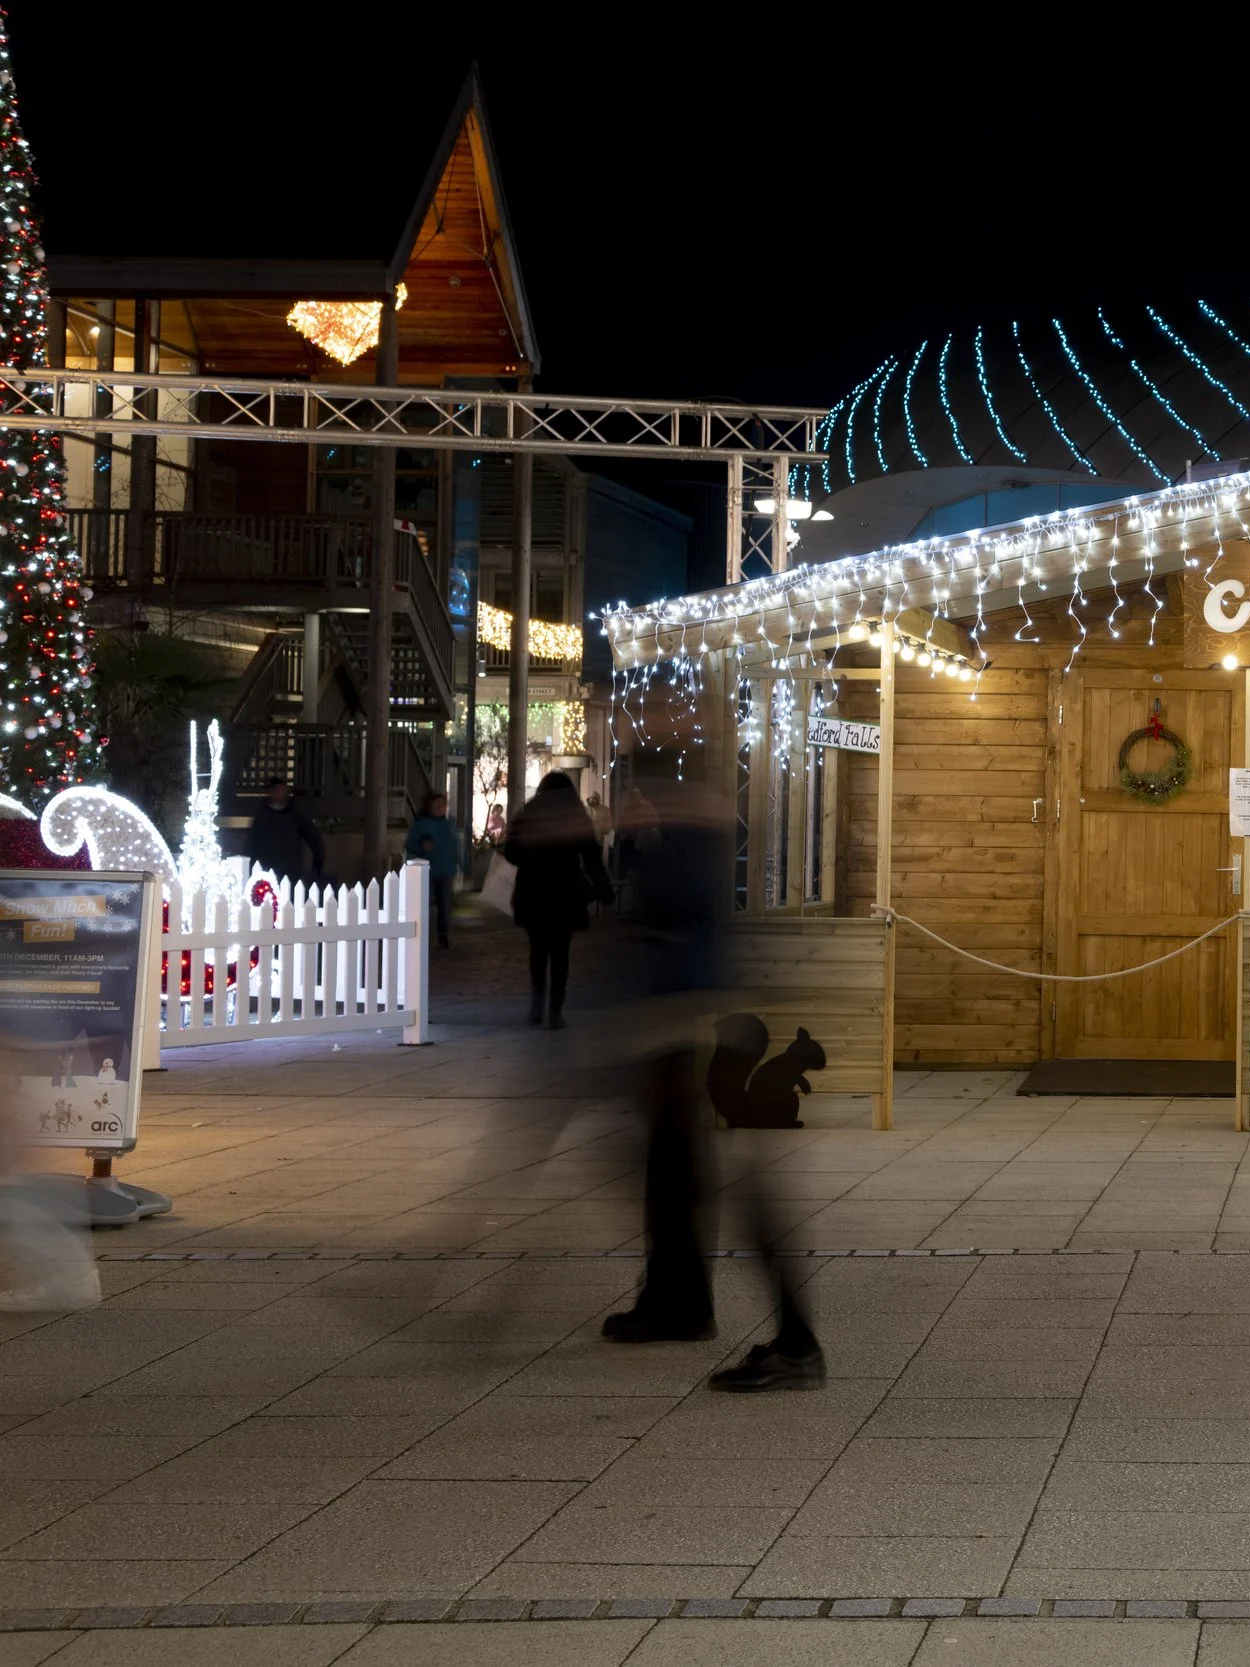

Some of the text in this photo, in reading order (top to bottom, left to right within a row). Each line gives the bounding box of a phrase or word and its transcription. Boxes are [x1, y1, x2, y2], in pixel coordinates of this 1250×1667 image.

[808, 720, 880, 750] edford Falls
[5, 900, 98, 915] Snow Much
[30, 924, 67, 938] Fun!
[15, 953, 62, 962] DECEMBER,
[64, 954, 104, 962] 11AM-3PM
[91, 1121, 119, 1132] arc
